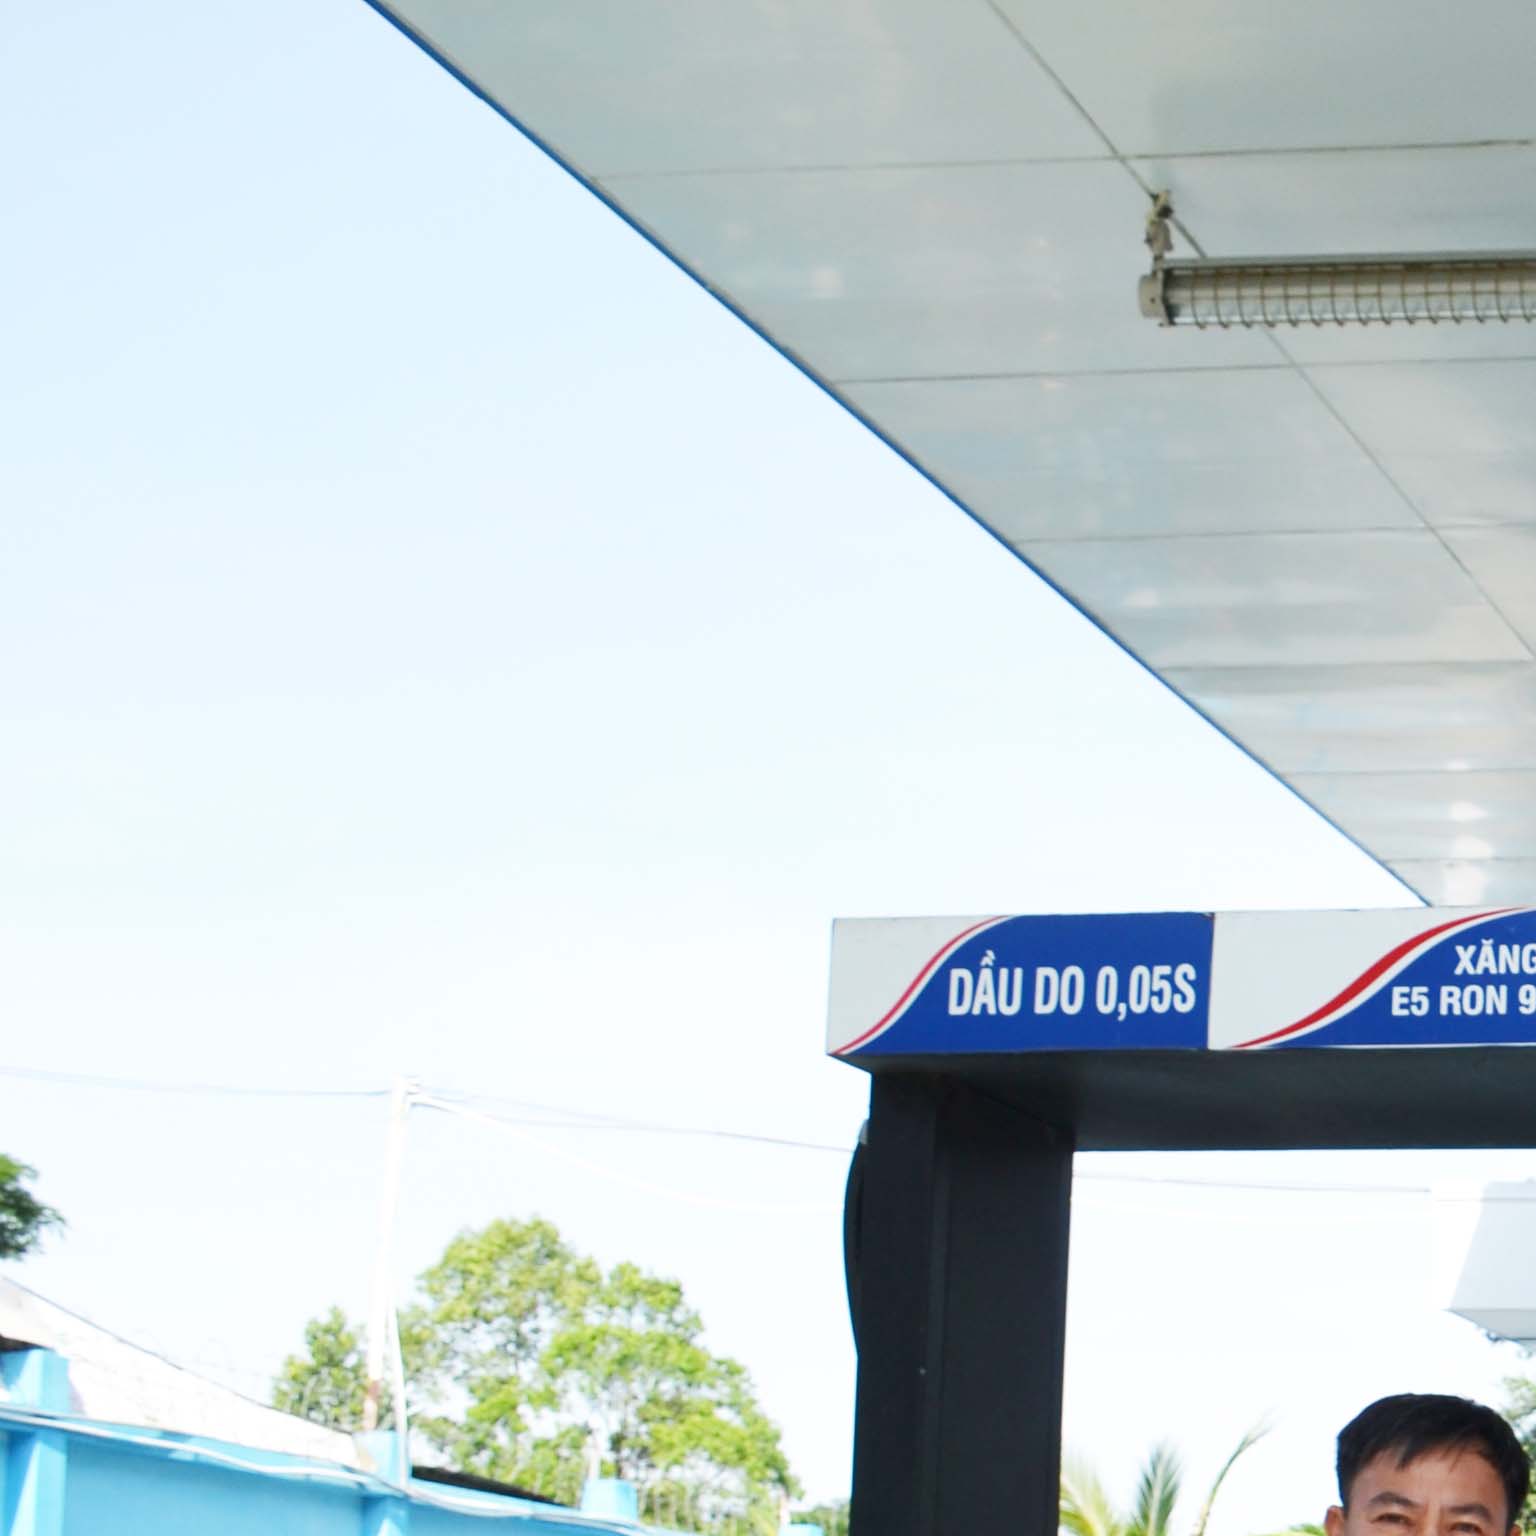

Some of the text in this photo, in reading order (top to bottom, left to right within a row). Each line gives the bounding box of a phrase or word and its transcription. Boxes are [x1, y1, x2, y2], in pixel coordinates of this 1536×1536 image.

[948, 949, 1197, 1021] DẦU DO 0,05S
[1391, 985, 1430, 1016] E5
[1439, 984, 1508, 1016] RON
